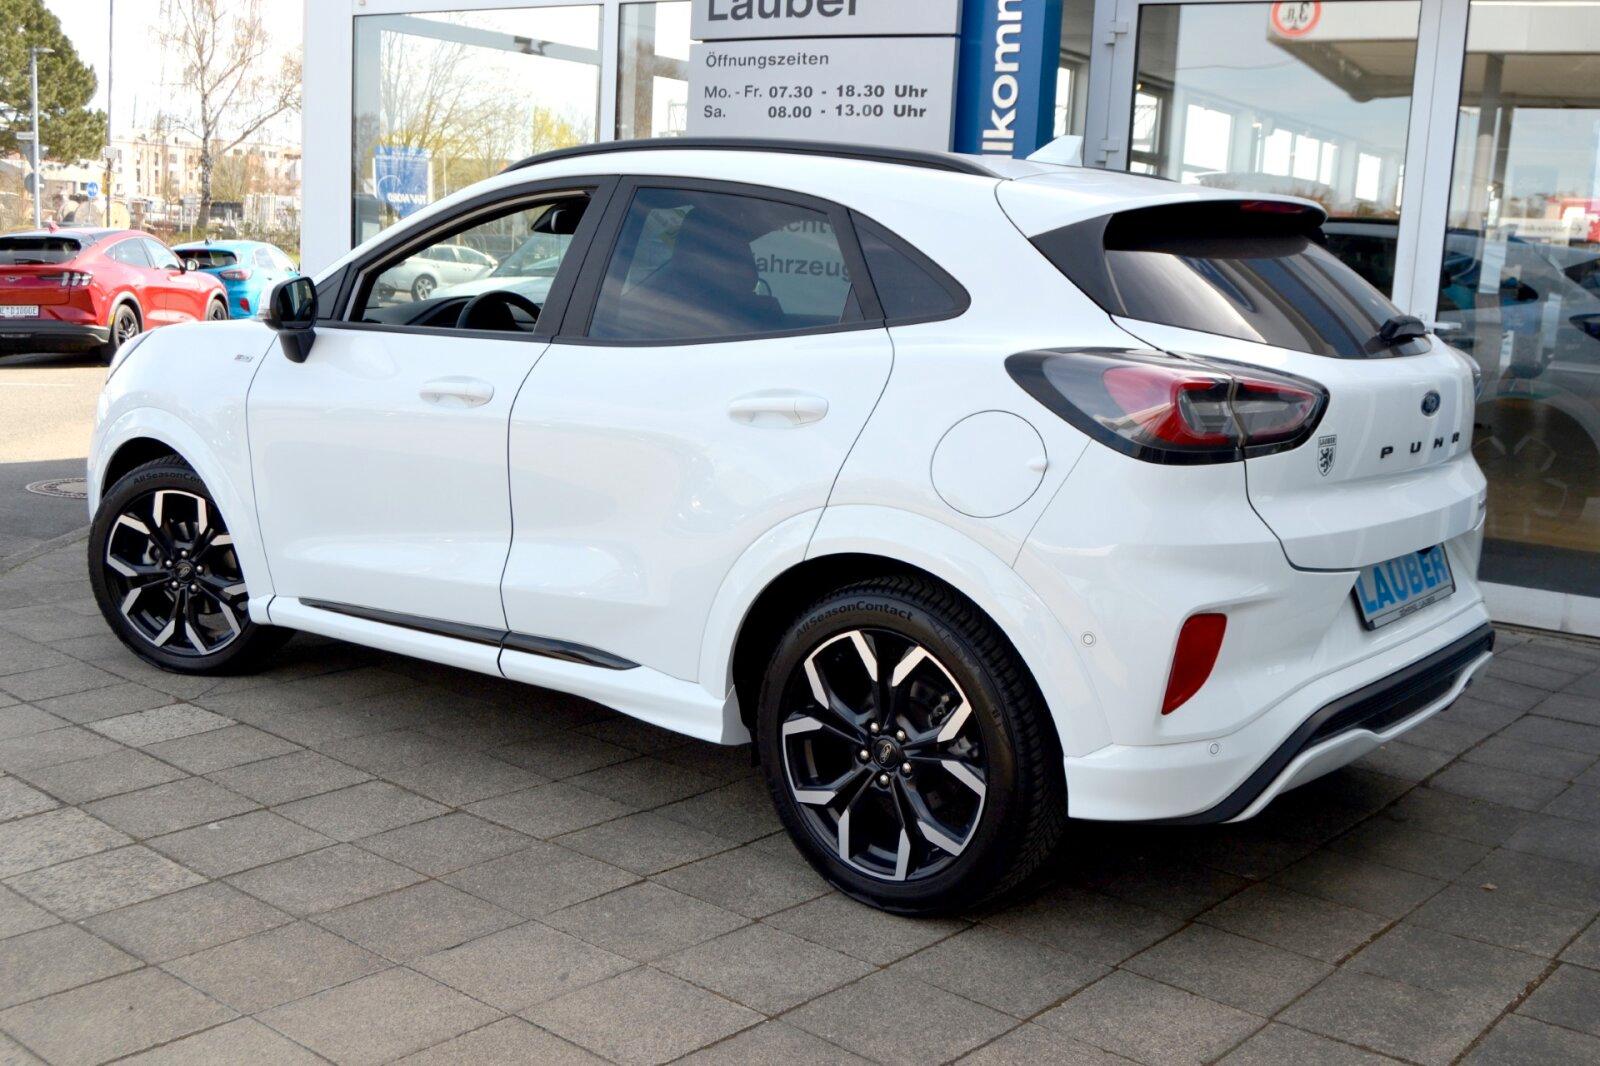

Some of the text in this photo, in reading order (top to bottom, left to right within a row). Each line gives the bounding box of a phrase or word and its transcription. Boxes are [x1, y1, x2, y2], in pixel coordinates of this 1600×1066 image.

[707, 0, 857, 21] Lauber
[706, 51, 829, 70] Öffnungszeiten
[704, 85, 732, 99] Mo.
[744, 84, 763, 98] Fr.
[768, 85, 813, 99] 07.30
[836, 84, 886, 98] 18.30
[894, 84, 928, 98] Uhr
[703, 104, 726, 118] Sa.
[768, 105, 812, 119] 08.00
[835, 103, 884, 117] 13.00
[893, 104, 927, 117] Uhr
[1355, 546, 1449, 614] LAUBER
[796, 600, 914, 639] AllSeasonContact
